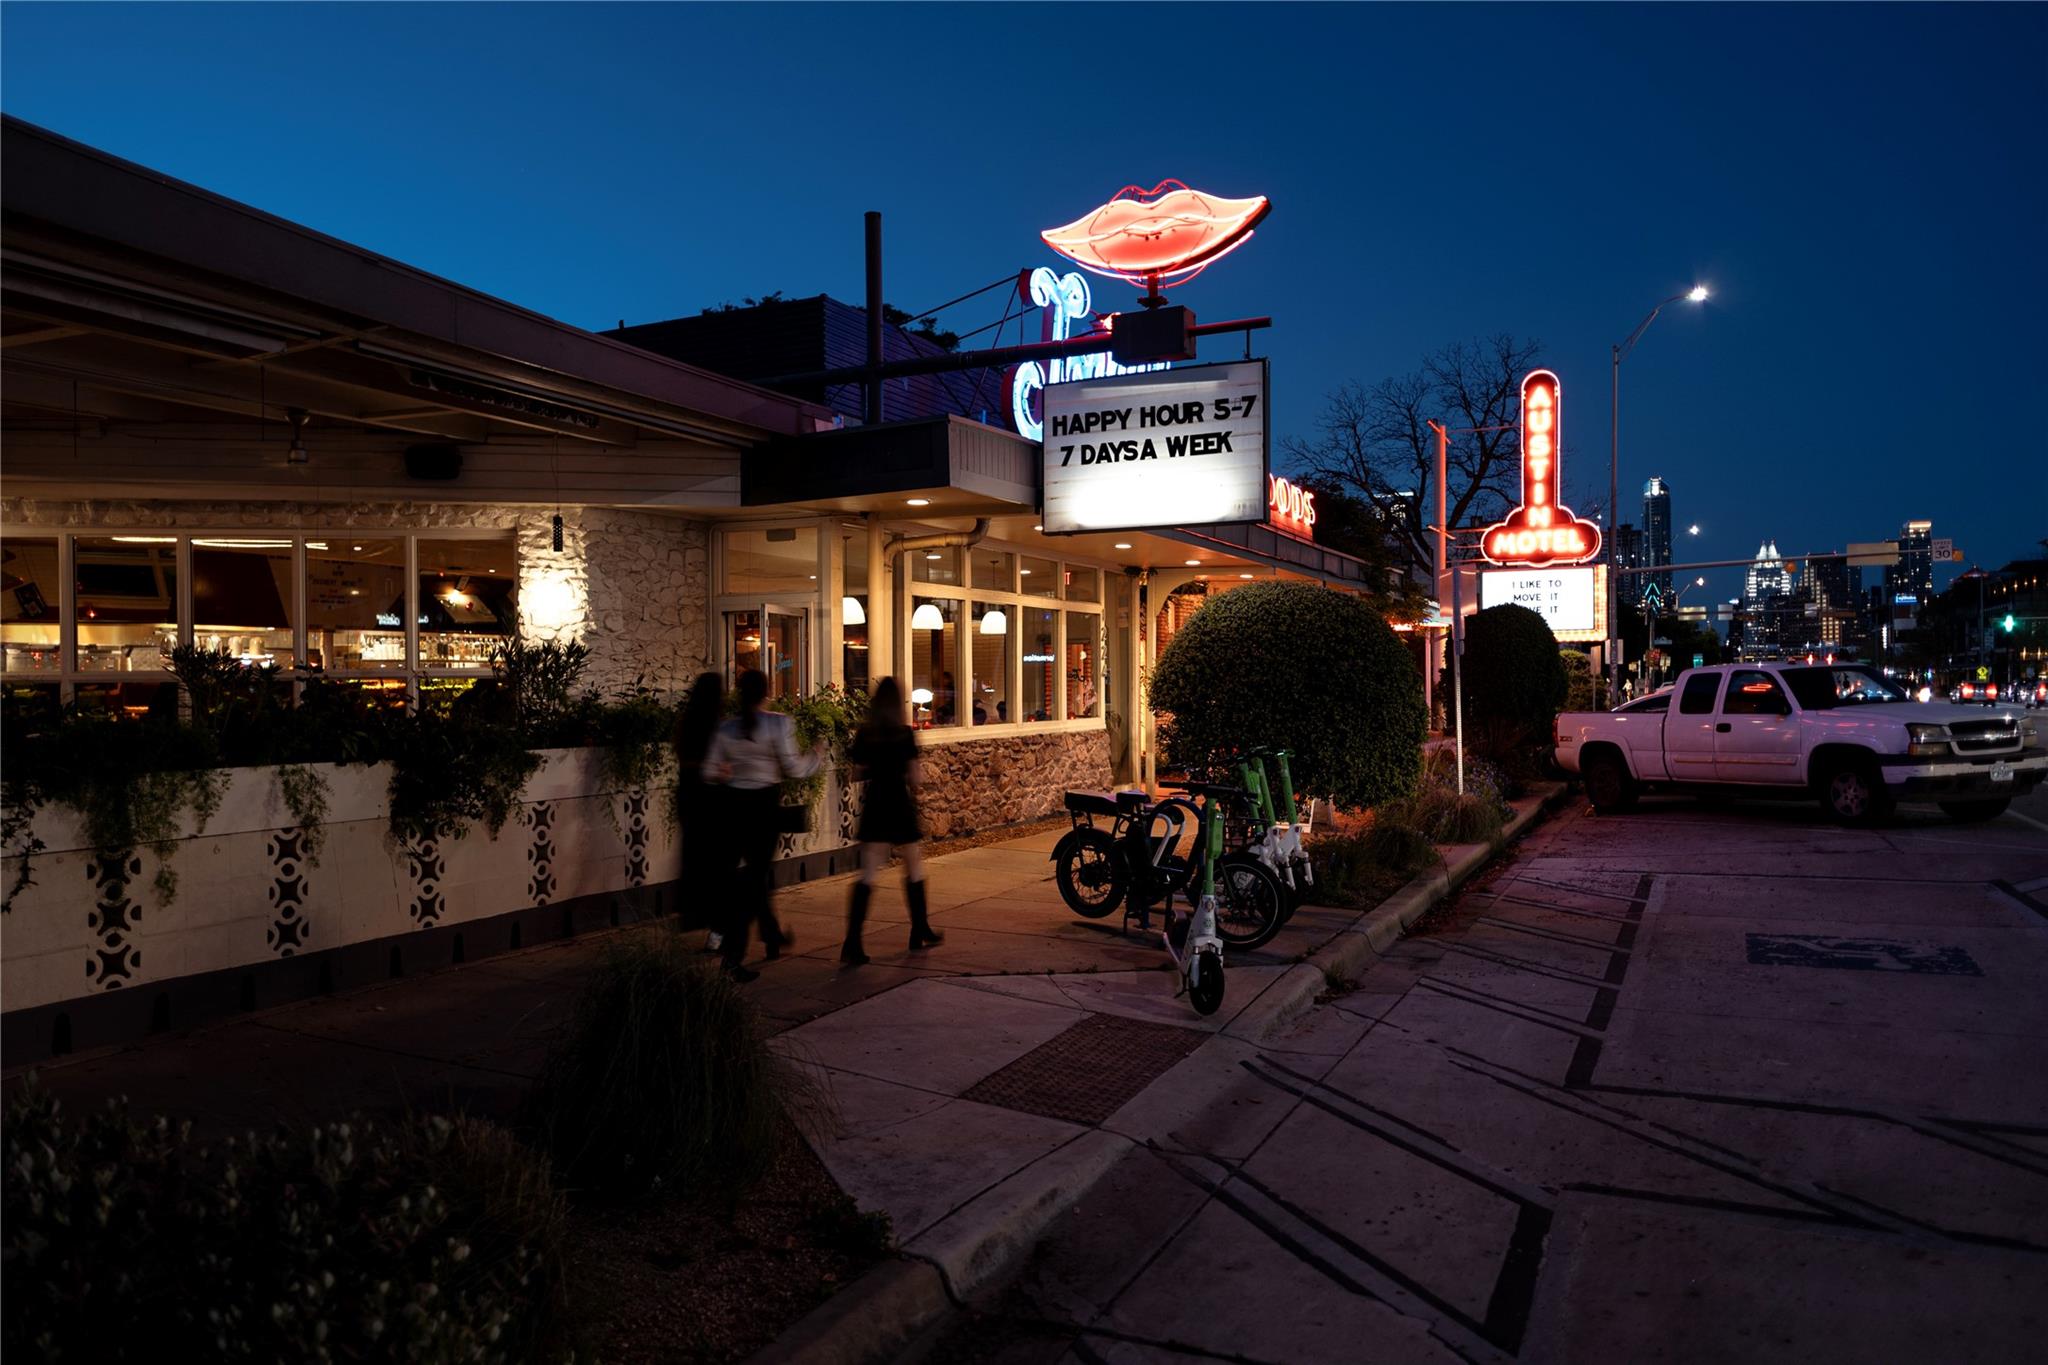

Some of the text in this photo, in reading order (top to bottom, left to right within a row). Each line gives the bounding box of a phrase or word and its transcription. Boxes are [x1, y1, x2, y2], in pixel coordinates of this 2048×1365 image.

[1052, 395, 1258, 436] HAPPY HOUR 5-7
[1060, 444, 1075, 467] 7
[1166, 431, 1233, 457] WEEK
[1527, 384, 1552, 528] AUSTIN
[1492, 529, 1585, 554] MOTEL
[1935, 550, 1950, 559] 30
[1520, 580, 1541, 588] LIKE
[1549, 580, 1562, 588] TO
[1513, 593, 1558, 601] MOVE IT
[1550, 605, 1558, 613] IT
